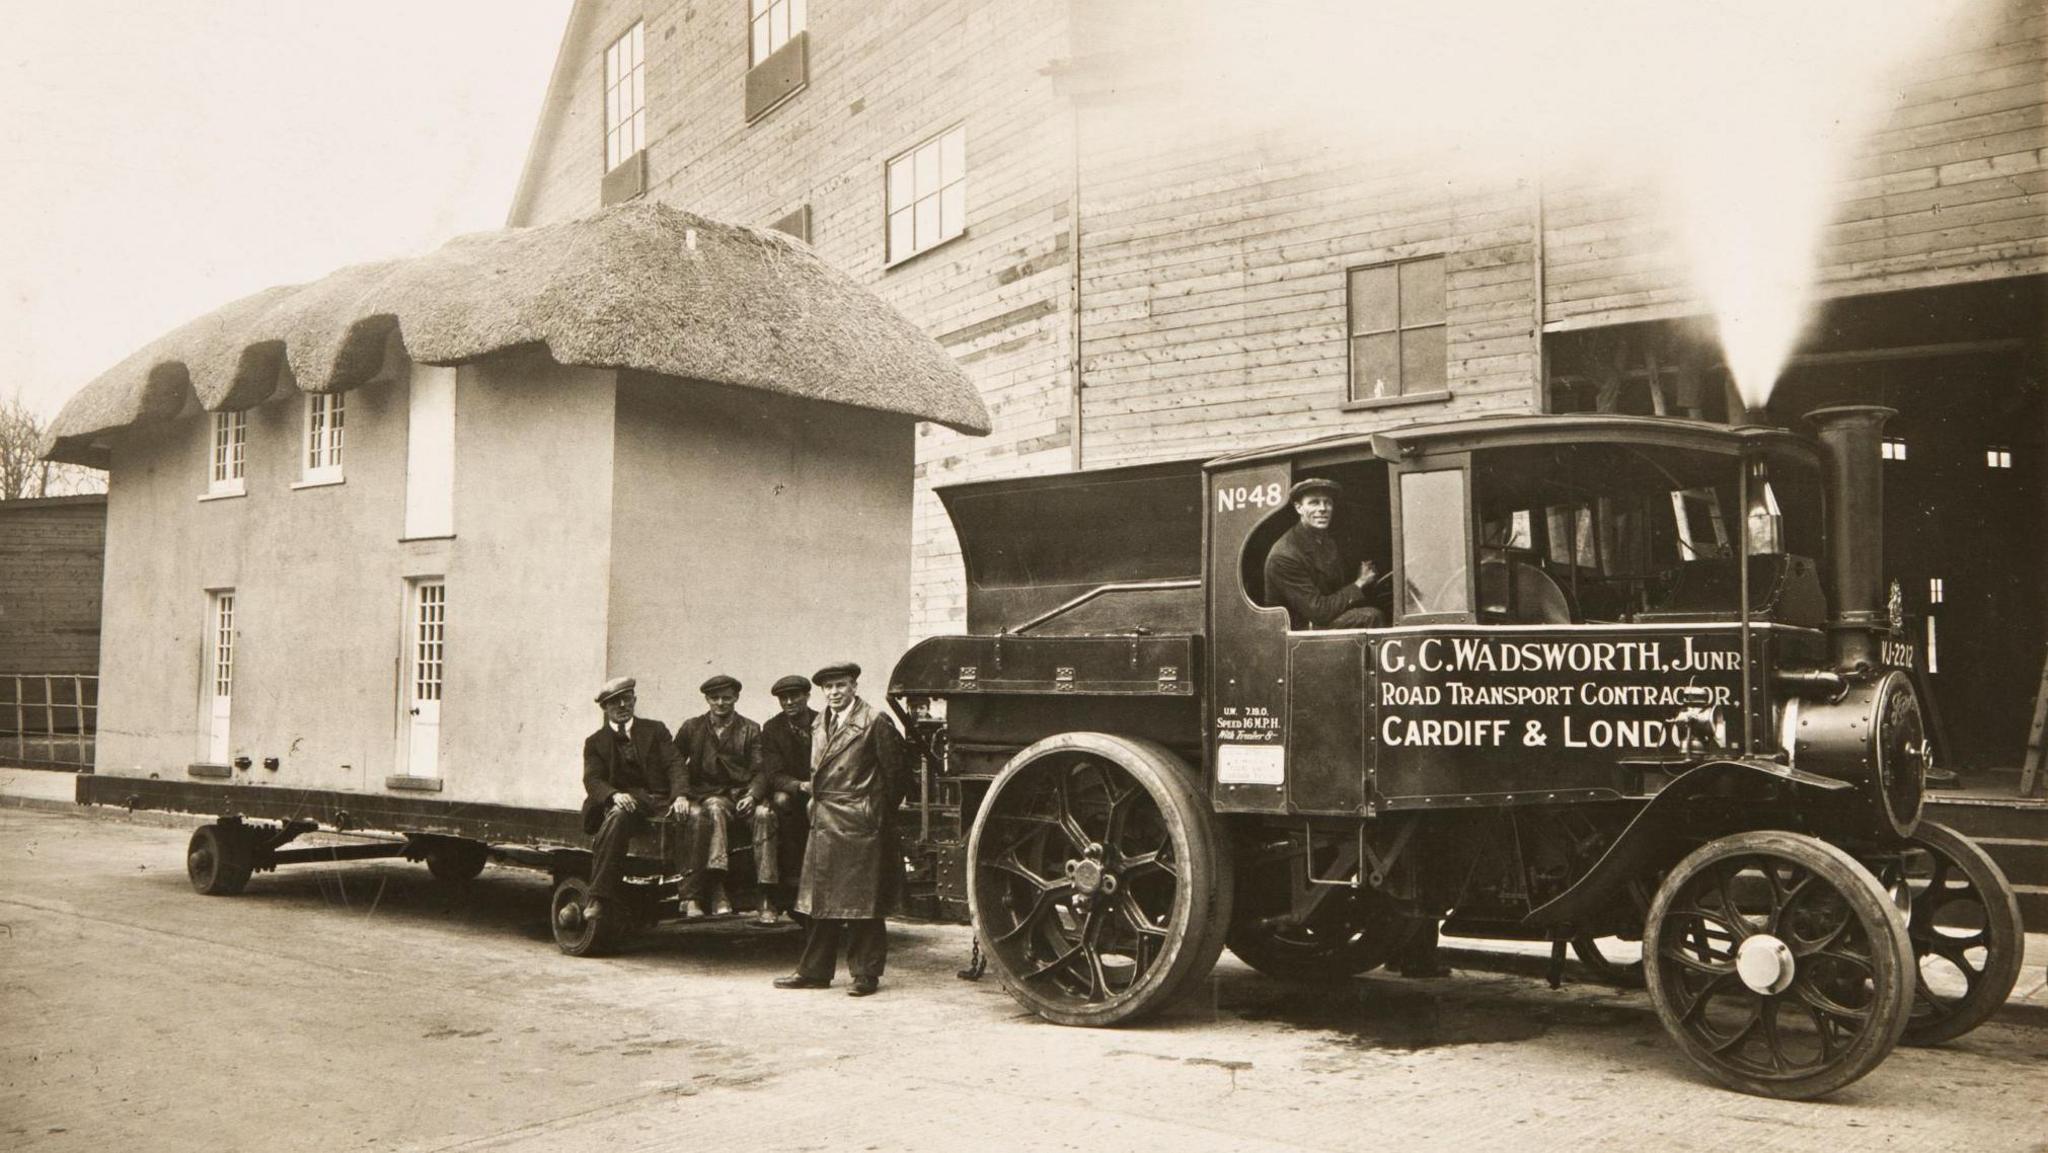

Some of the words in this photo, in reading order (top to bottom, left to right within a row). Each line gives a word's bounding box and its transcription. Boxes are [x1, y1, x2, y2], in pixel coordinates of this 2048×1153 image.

[1381, 682, 1441, 706] ROAD
[1445, 682, 1575, 705] TRANSPORT
[1580, 682, 1741, 707] CONTRACOR,
[1382, 715, 1511, 747] CARDIFF
[1522, 719, 1548, 747] &
